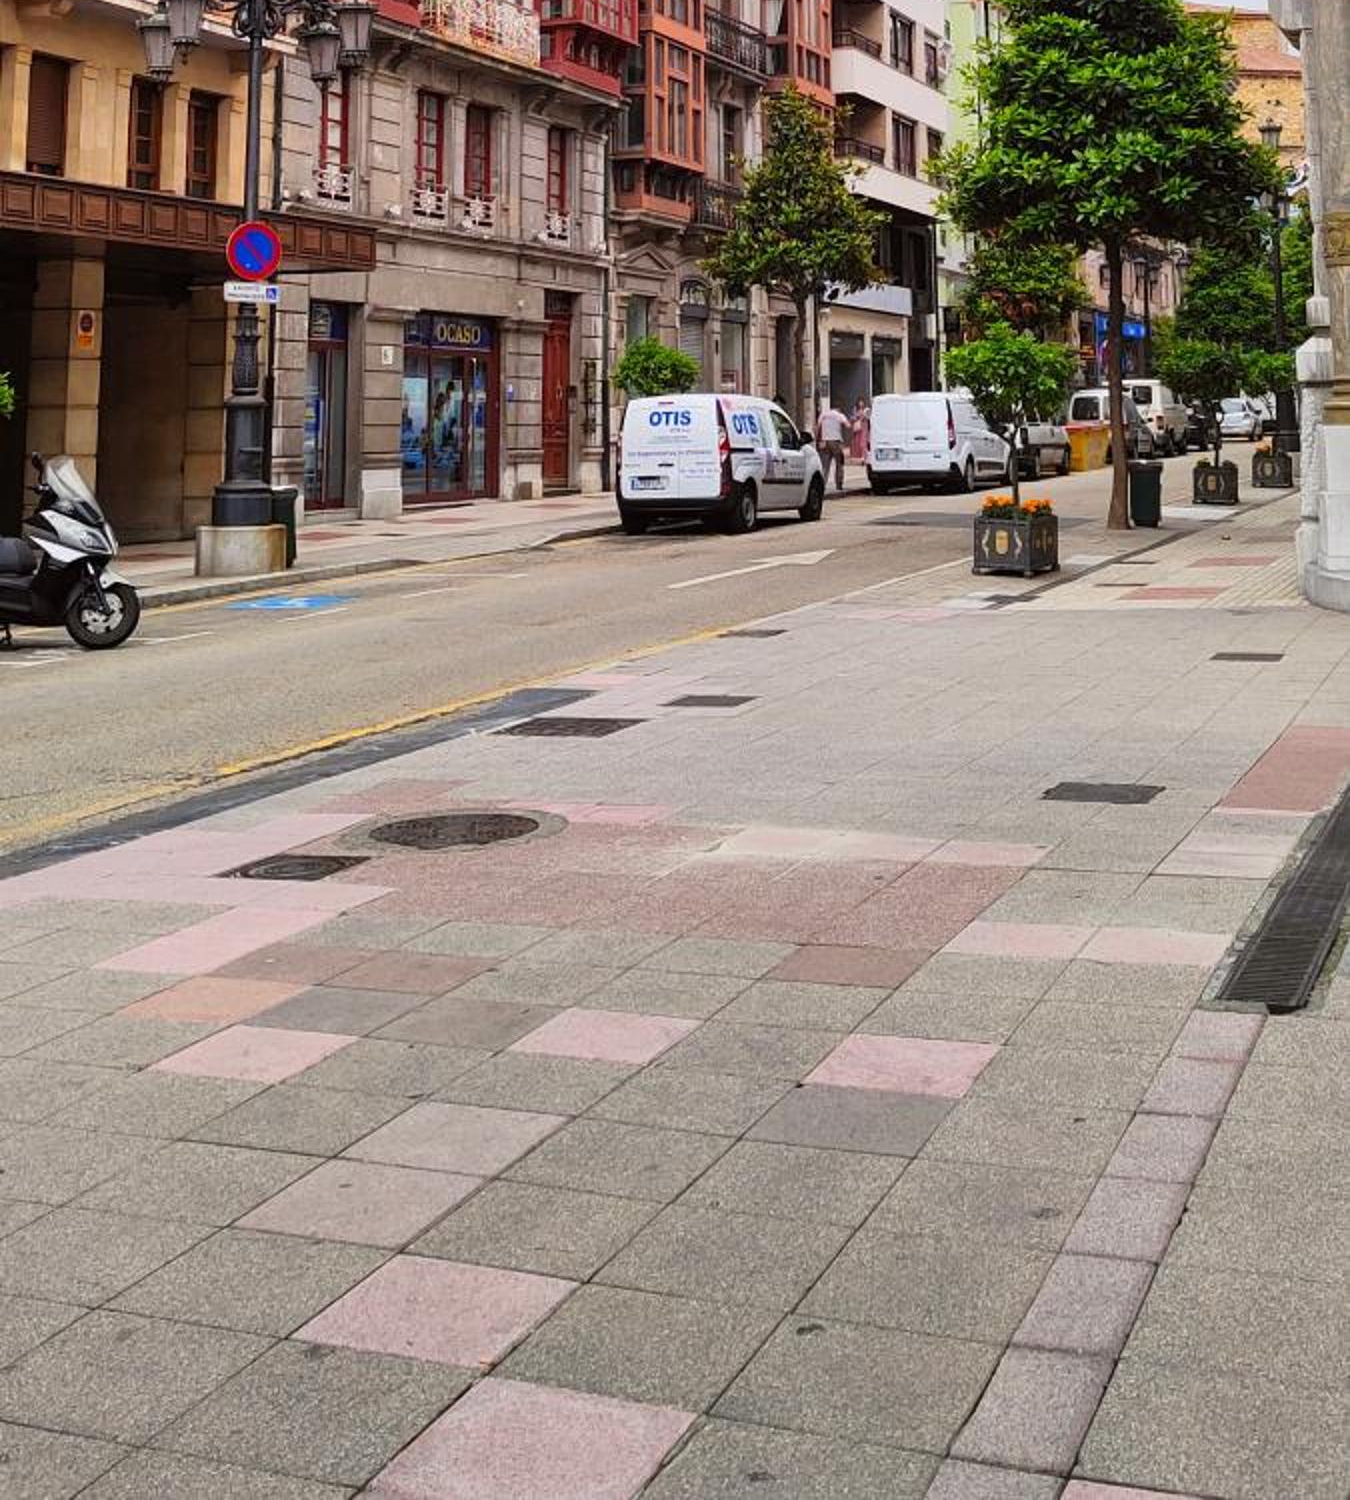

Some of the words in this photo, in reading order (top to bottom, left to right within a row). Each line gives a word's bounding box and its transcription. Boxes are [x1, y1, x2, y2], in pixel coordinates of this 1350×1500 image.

[436, 323, 482, 344] OCASO
[649, 410, 692, 426] OTIS
[731, 413, 758, 435] OTIS
